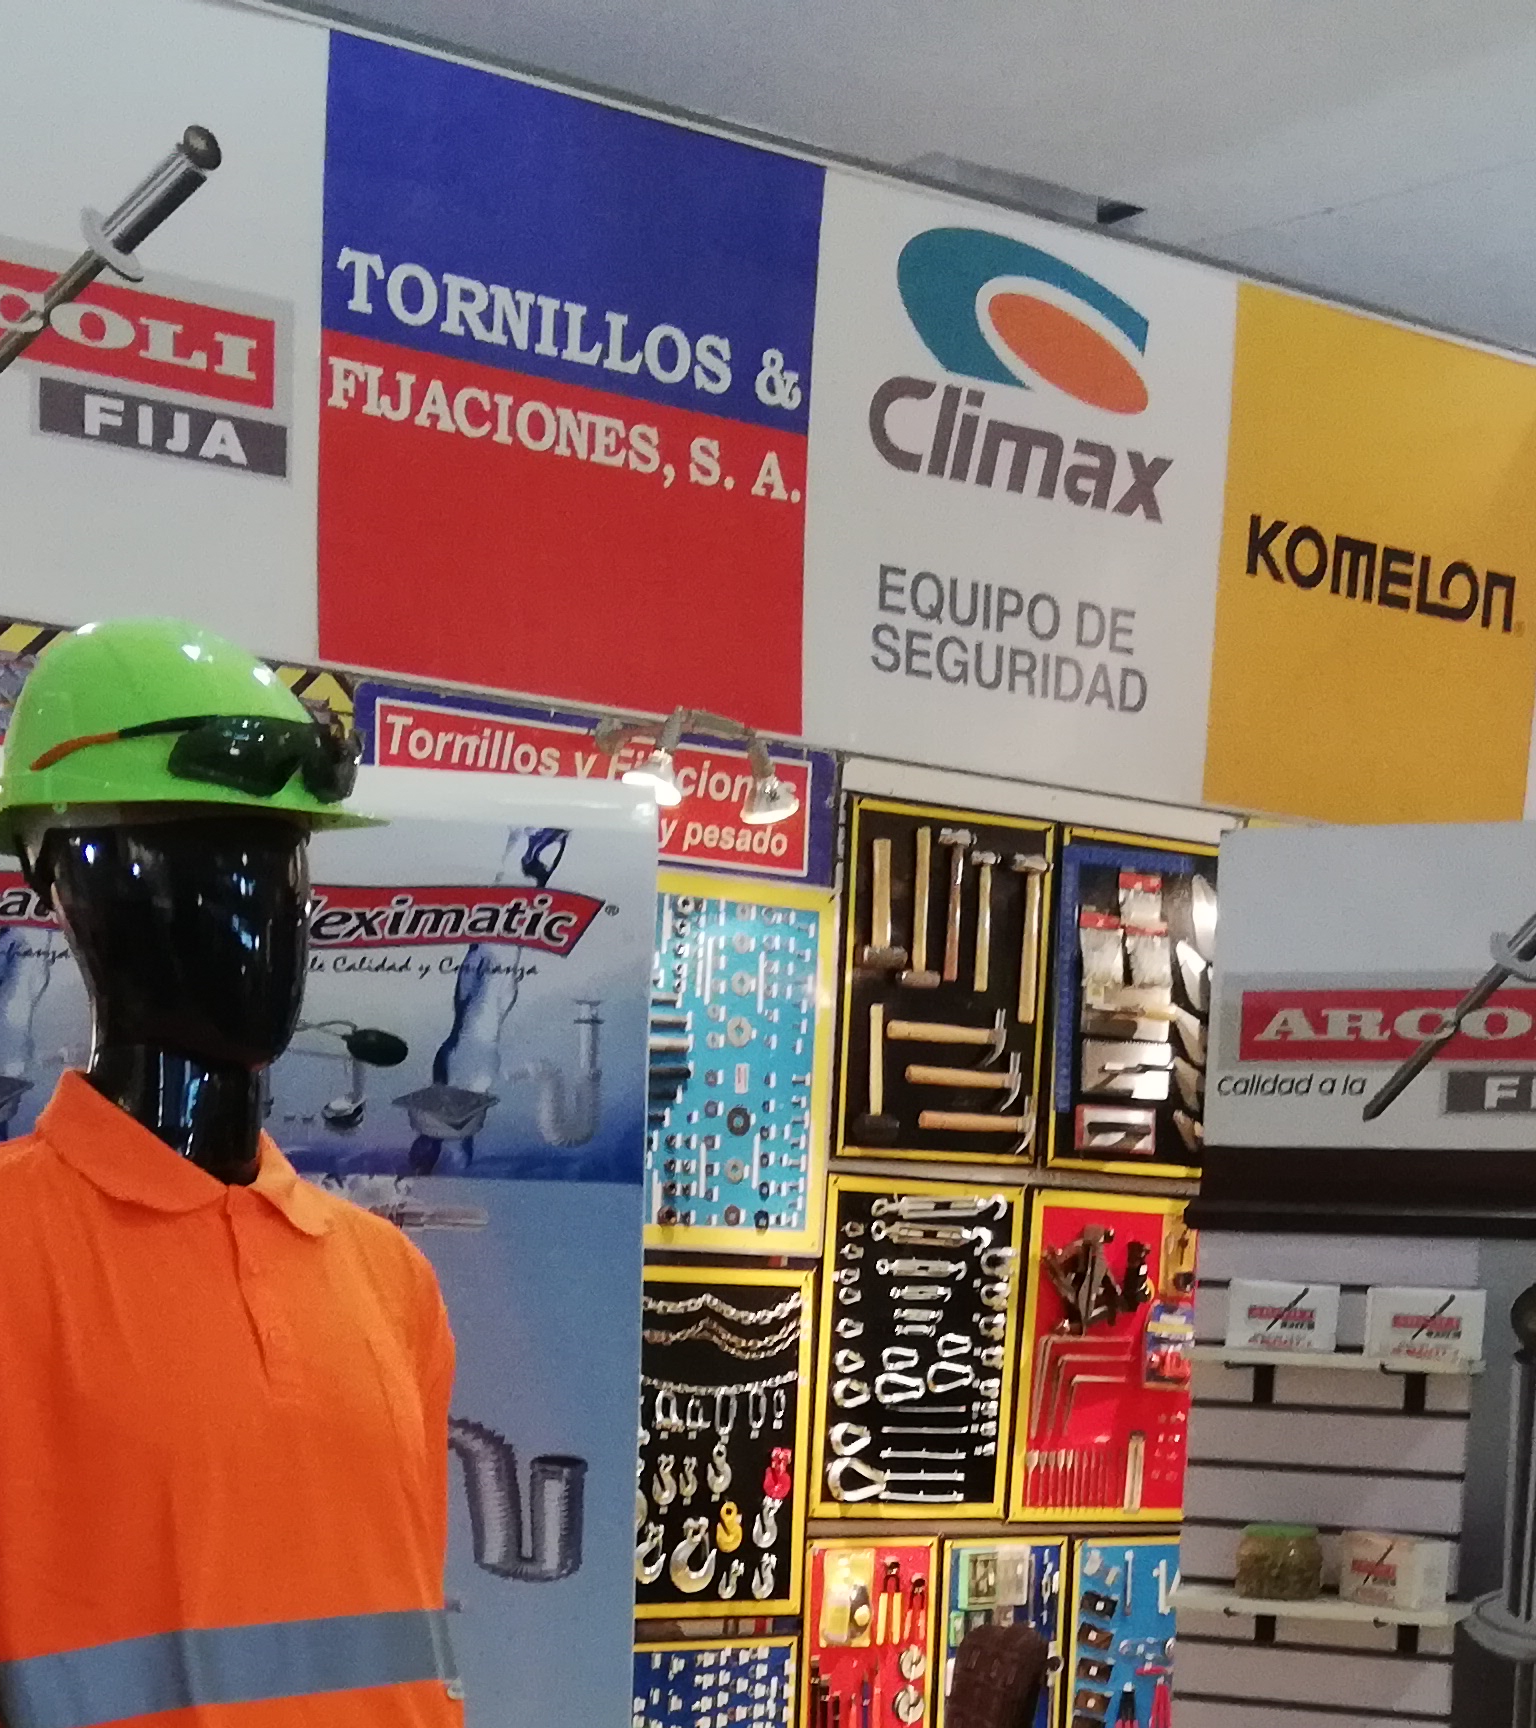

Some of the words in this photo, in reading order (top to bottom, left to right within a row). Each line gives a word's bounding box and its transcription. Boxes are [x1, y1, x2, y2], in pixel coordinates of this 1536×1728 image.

[336, 246, 732, 396] TORNILLOS
[755, 347, 802, 411] &
[83, 393, 248, 466] FIJA
[326, 355, 676, 491] FIJACIONES,
[689, 438, 735, 494] S.
[751, 450, 804, 503] A.
[869, 375, 1175, 525] Climax
[878, 563, 1061, 642] EQUIPO
[1076, 602, 1136, 655] DE
[870, 624, 1149, 715] SEGURIDAD
[385, 714, 560, 777] Tornillos
[682, 824, 788, 857] pesado
[332, 955, 412, 973] Calidad
[1218, 1073, 1313, 1097] Calidad
[1319, 1080, 1336, 1096] a
[1341, 1074, 1366, 1096] la
